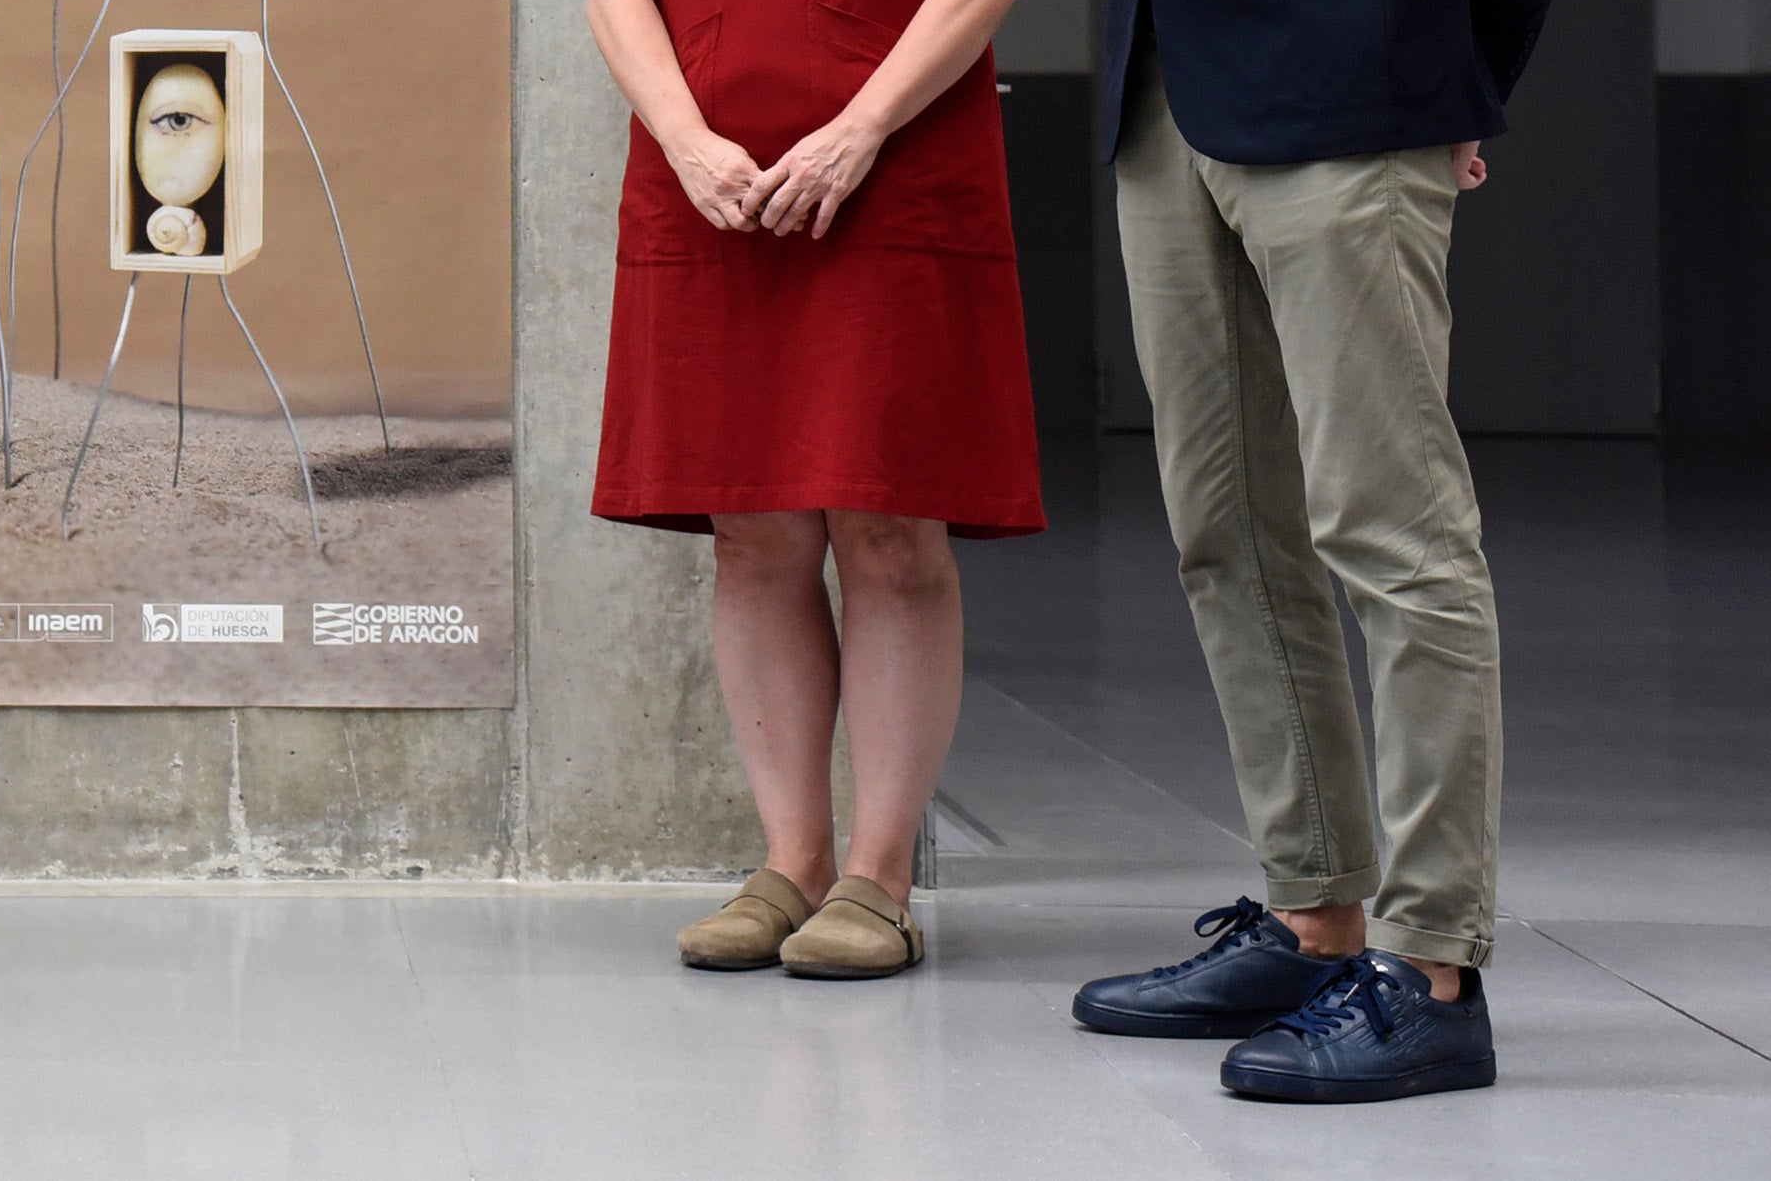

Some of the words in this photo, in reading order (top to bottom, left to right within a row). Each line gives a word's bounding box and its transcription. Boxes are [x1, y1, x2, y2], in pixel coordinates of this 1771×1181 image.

[28, 614, 103, 632] inaem
[187, 608, 269, 622] DIPUTACIÓN
[354, 605, 464, 623] GOBIERNO
[187, 625, 206, 637] DE
[211, 625, 269, 637] HUESCA
[354, 625, 382, 643] DE
